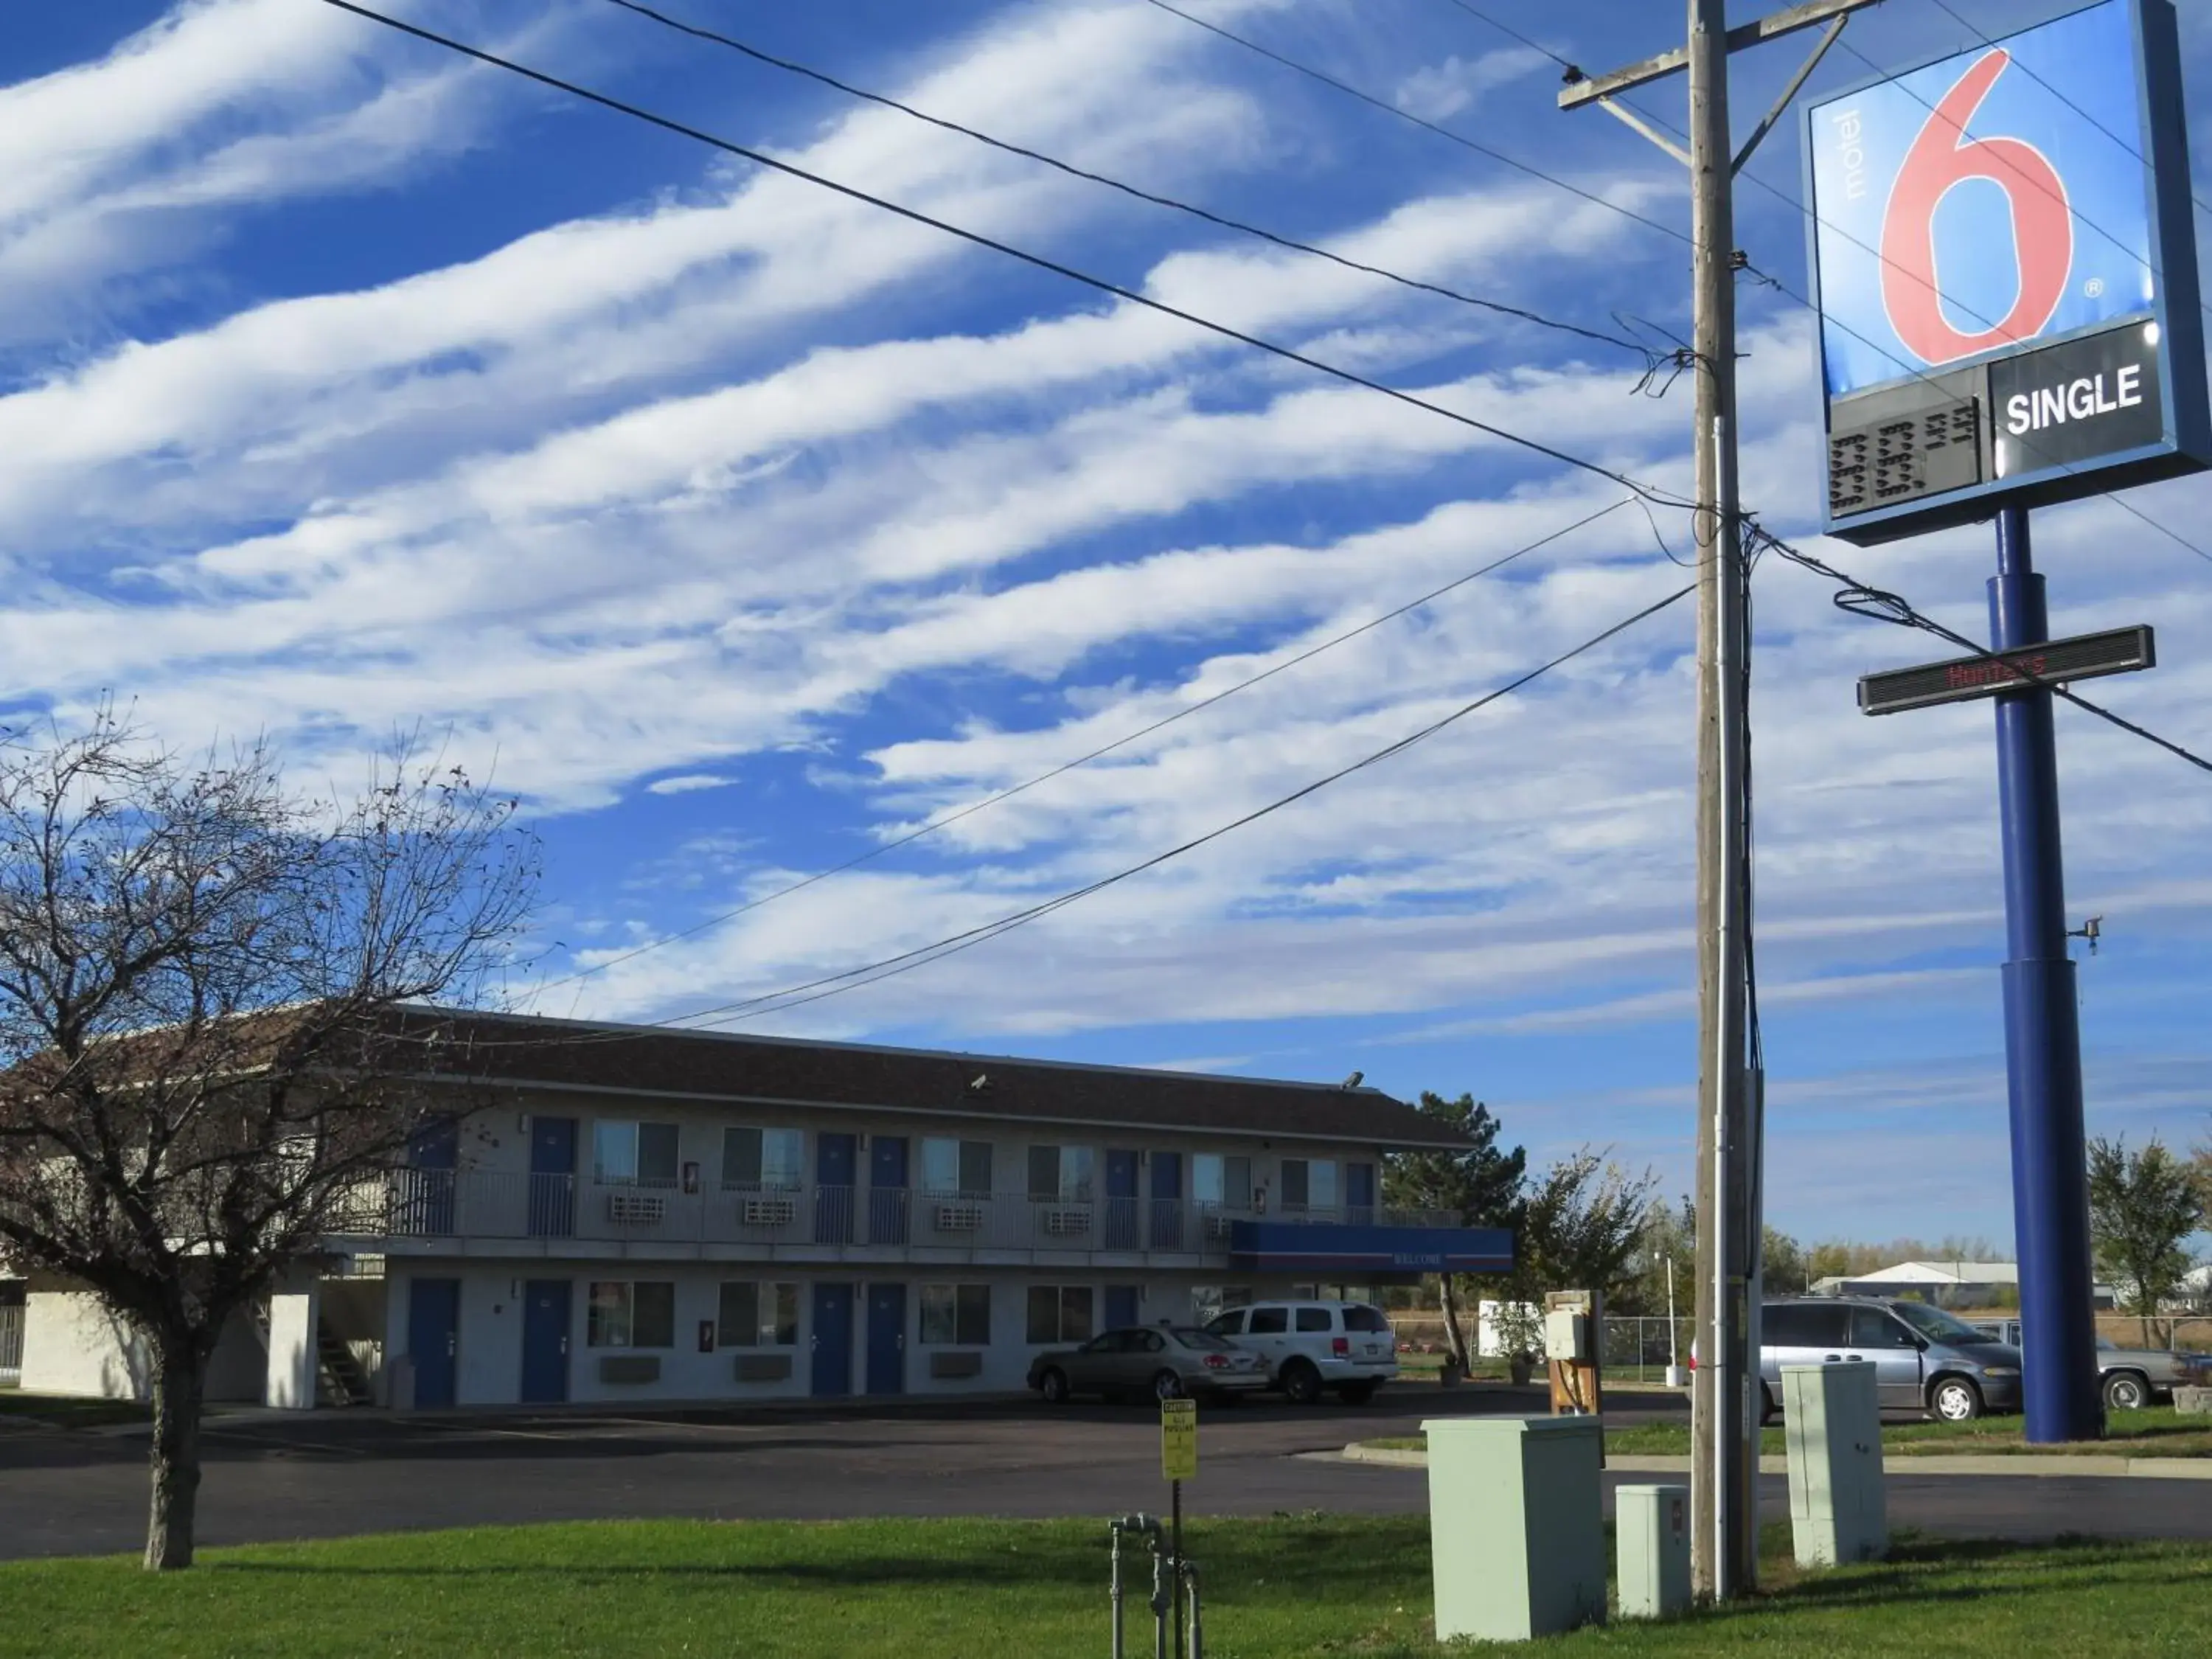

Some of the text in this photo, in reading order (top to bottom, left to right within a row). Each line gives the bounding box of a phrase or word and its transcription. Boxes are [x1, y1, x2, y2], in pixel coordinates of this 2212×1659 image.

[1832, 109, 1865, 200] motel
[1879, 48, 2073, 366] 6
[2007, 364, 2142, 435] SINGLE
